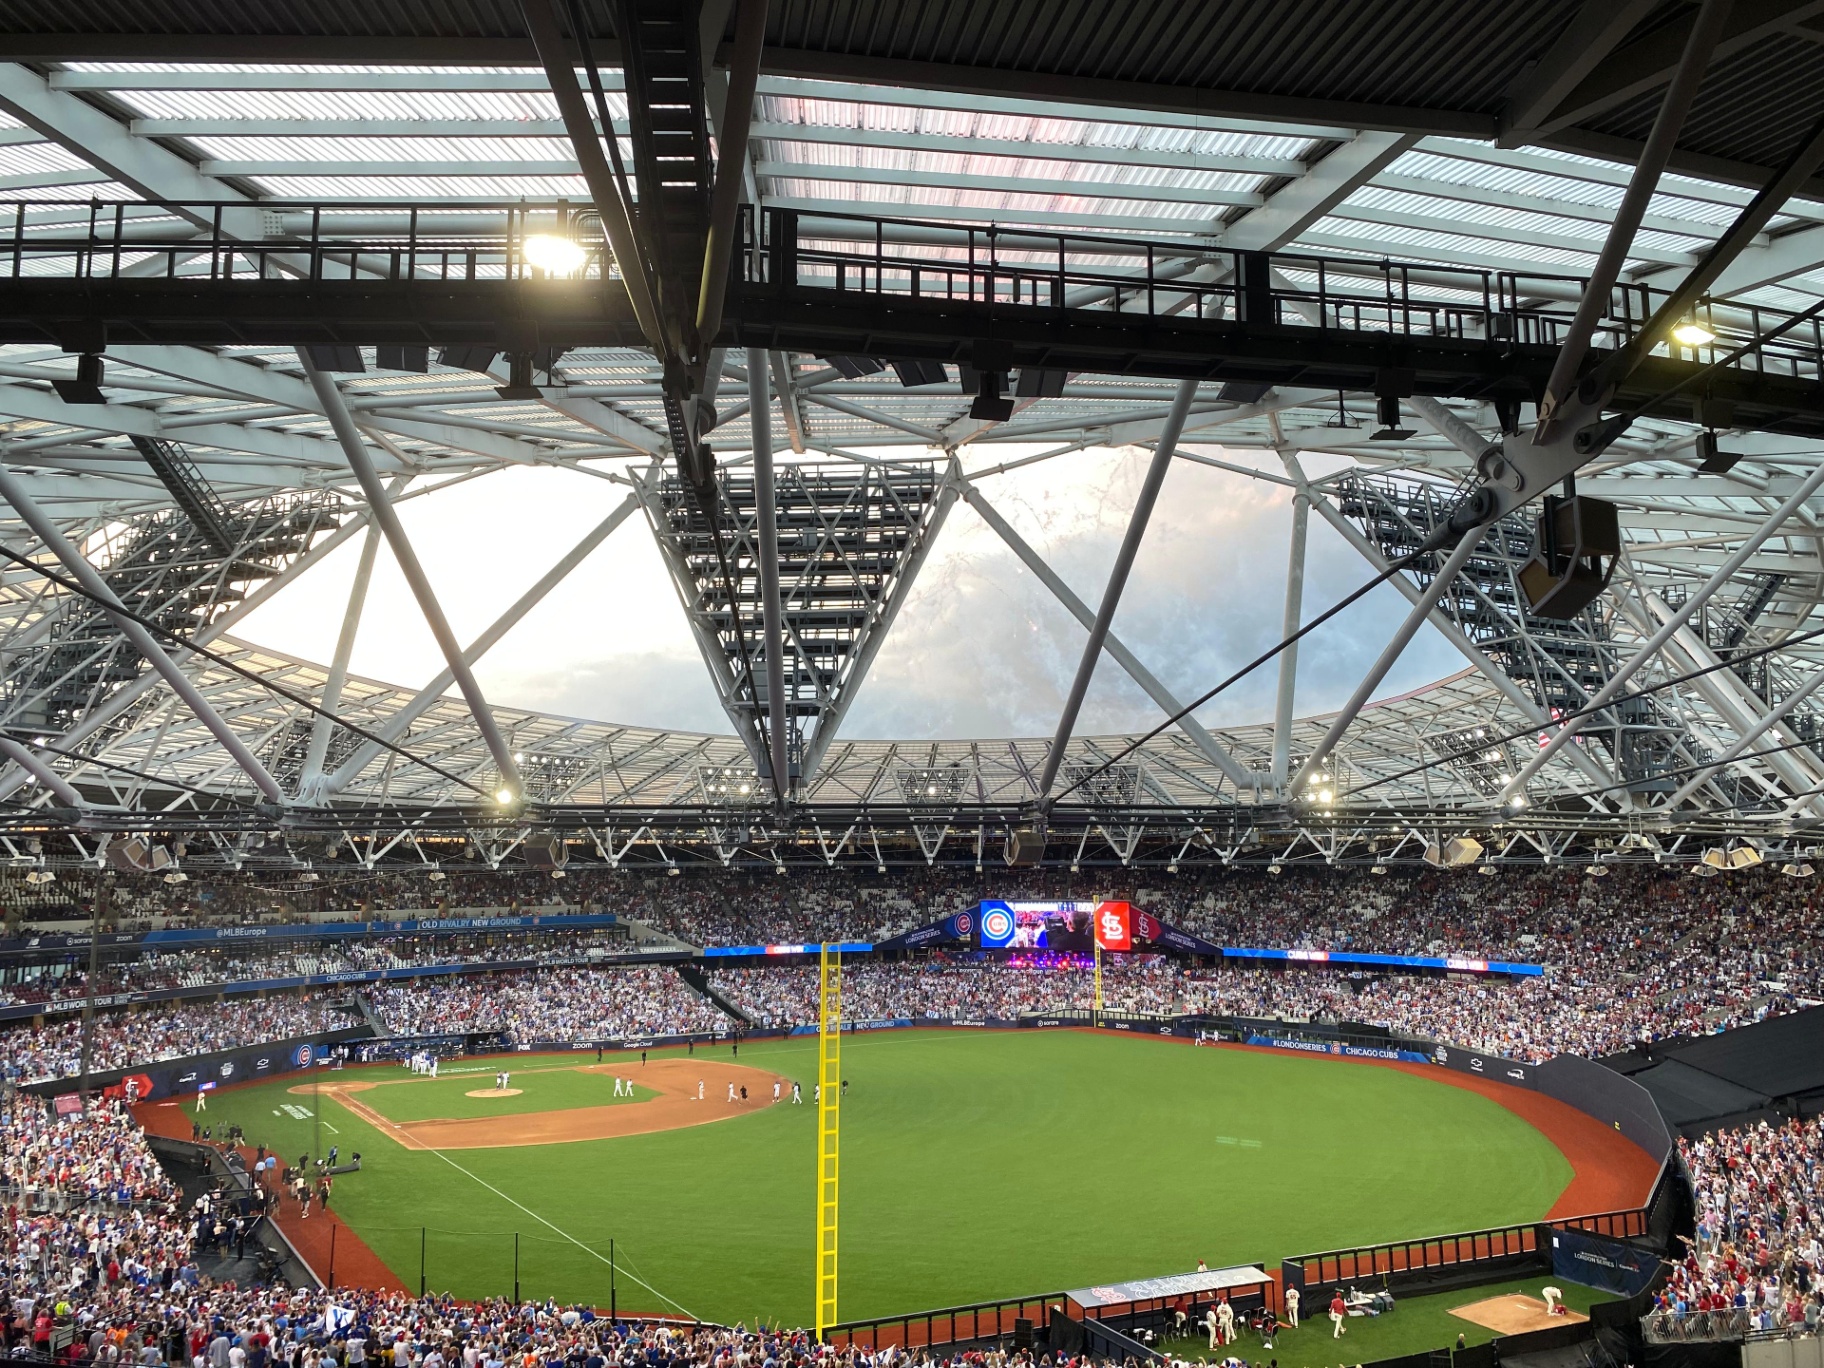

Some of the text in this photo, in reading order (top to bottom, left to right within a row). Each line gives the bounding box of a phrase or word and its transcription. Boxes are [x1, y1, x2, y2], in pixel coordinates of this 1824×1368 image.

[421, 918, 521, 929] OLD RIVALRY NEW GROUND
[216, 927, 267, 938] @MLBEurope
[326, 973, 351, 982] CHICAGO
[52, 997, 112, 1011] MLB WORL TOUR
[1115, 1022, 1129, 1030] zoom
[1272, 1039, 1399, 1059] #LONDONSERIES CHICAGO CUBS
